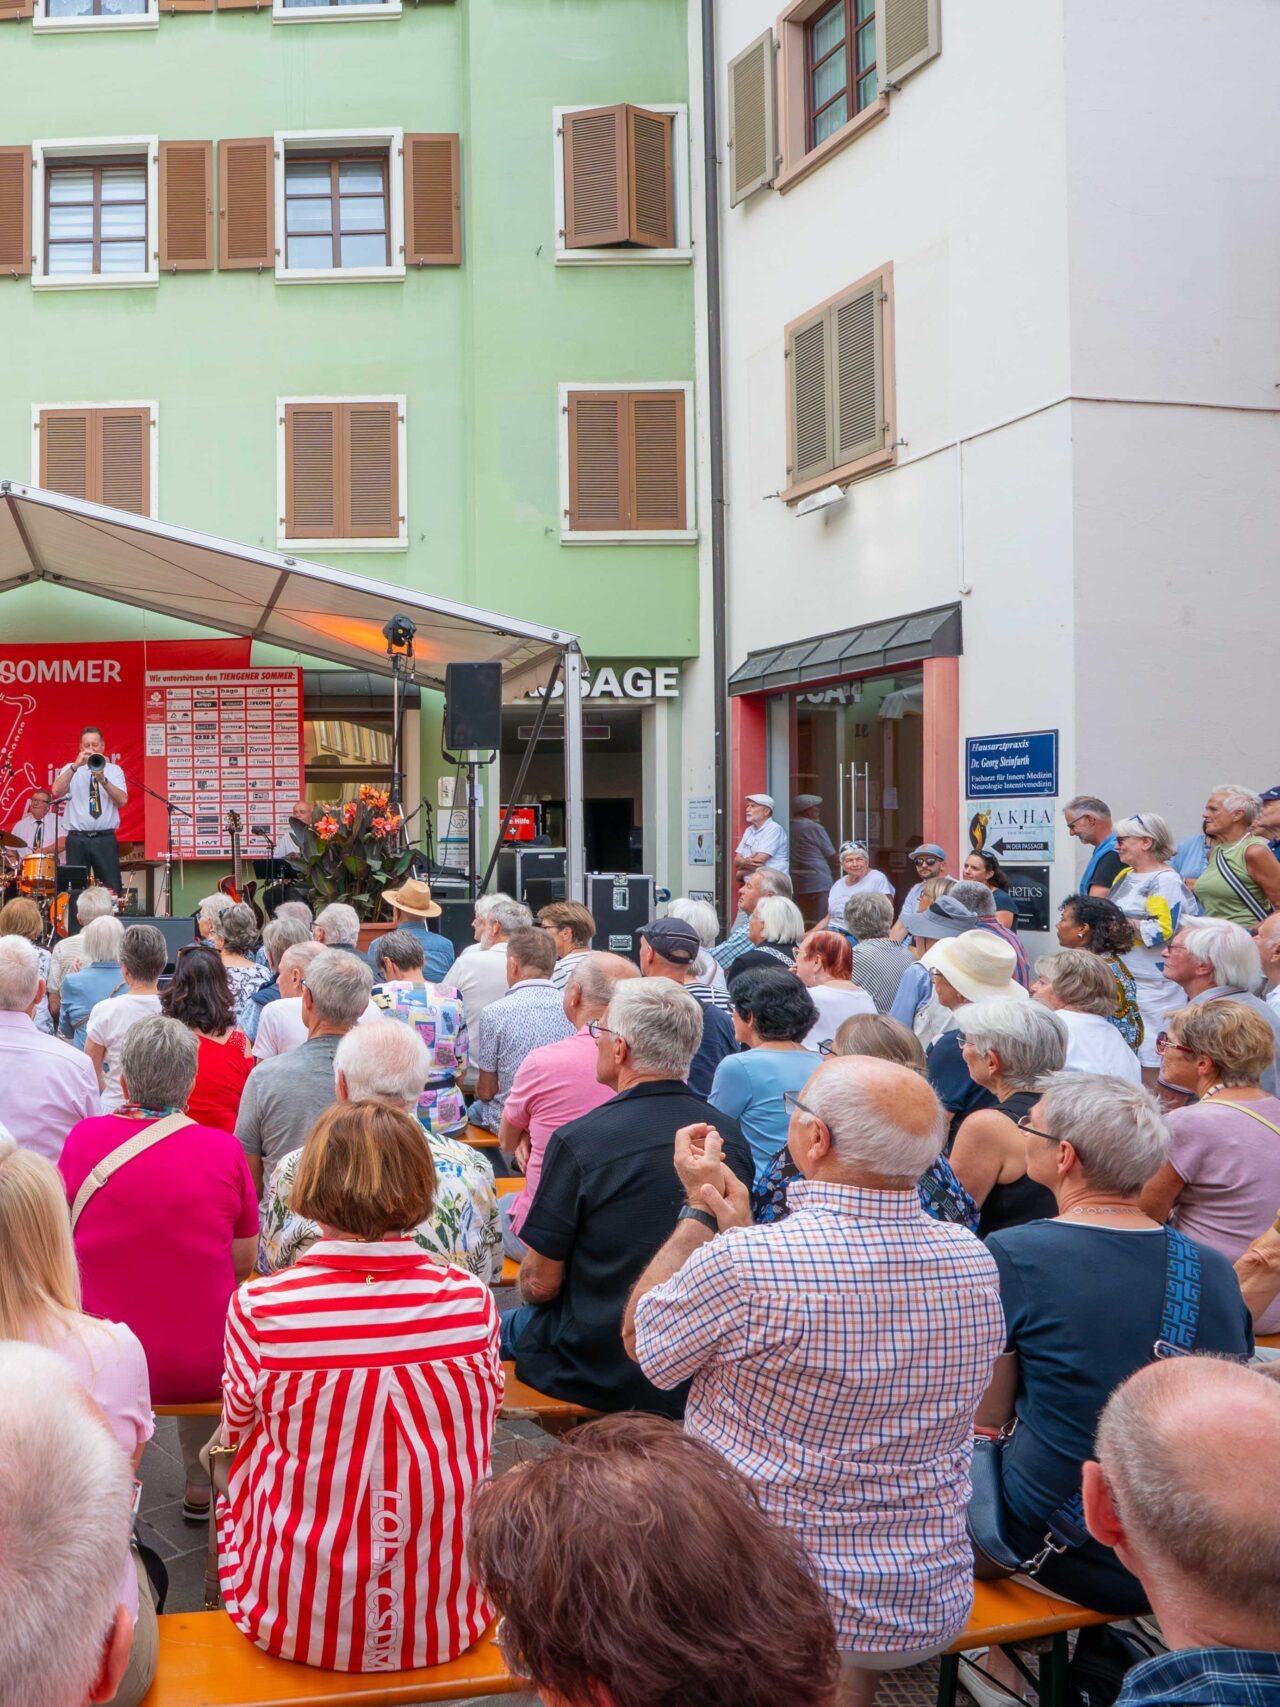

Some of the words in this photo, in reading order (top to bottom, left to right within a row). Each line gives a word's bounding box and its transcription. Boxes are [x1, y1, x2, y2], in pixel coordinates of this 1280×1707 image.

[149, 674, 161, 682] Wir
[205, 673, 218, 681] den
[220, 672, 259, 681] TIENGENER
[261, 671, 296, 680] SOMMER:
[971, 739, 1030, 752] Hausarztpraxis
[970, 758, 980, 769] Dr.
[981, 757, 999, 770] Georg
[999, 755, 1030, 768] Steinfurth
[971, 774, 995, 782] Facharzt
[996, 773, 1005, 781] für
[1006, 773, 1025, 781] Innere
[1026, 771, 1052, 779] Medizin
[971, 782, 1003, 791] Neurologie
[1004, 781, 1052, 789] Intensivmedizin
[514, 817, 530, 825] Hilfe
[994, 808, 1051, 825] AKHA
[1021, 842, 1044, 850] PASSAGE
